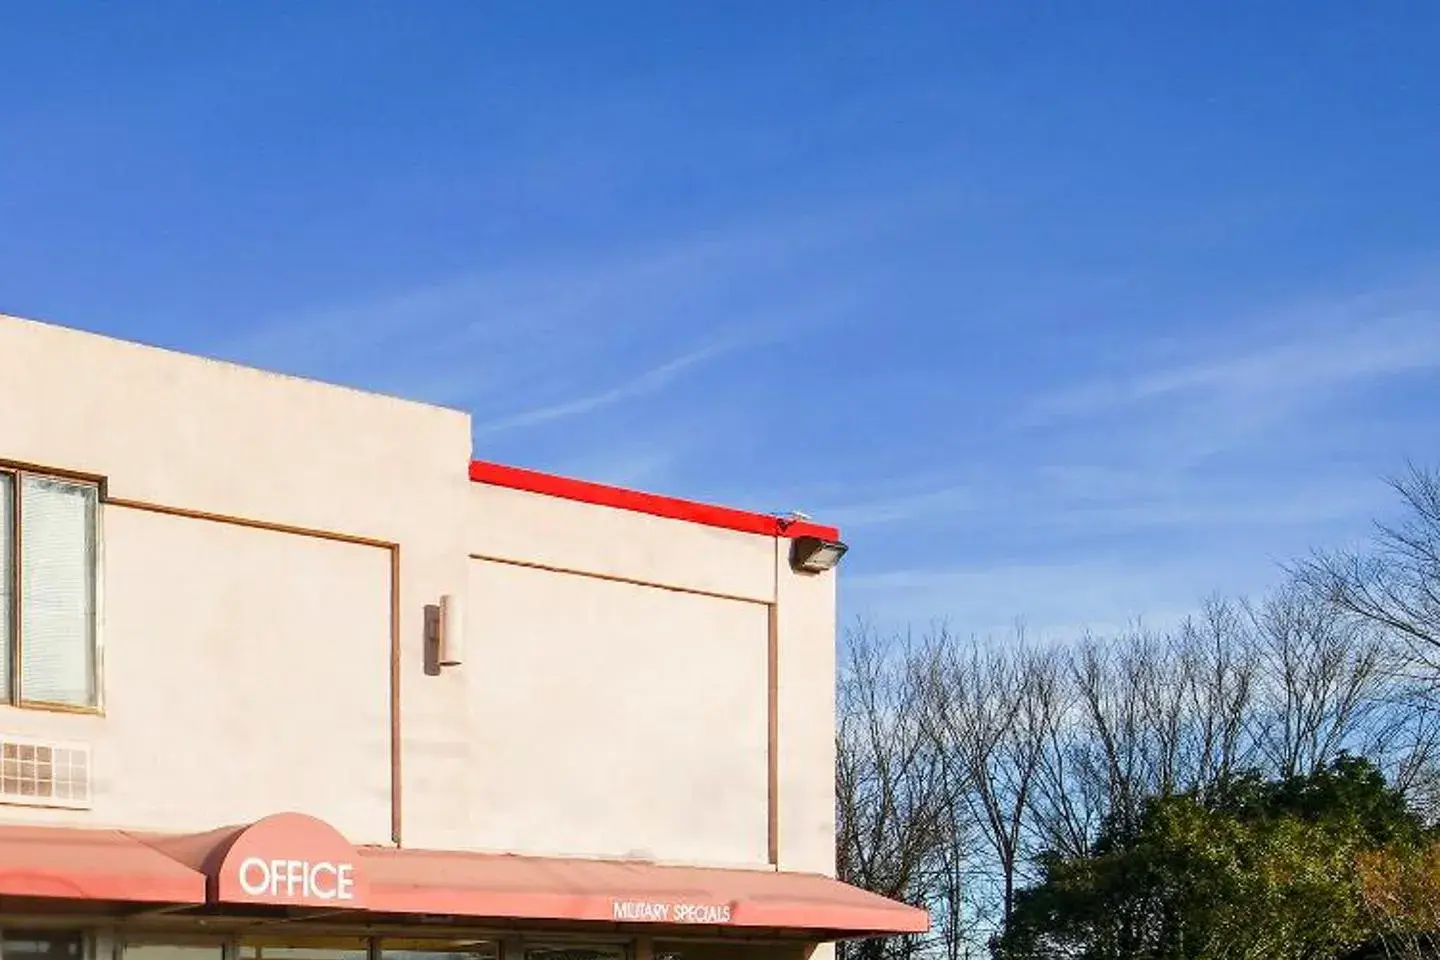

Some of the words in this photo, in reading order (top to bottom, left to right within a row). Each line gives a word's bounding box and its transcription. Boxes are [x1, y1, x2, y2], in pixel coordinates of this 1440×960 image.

[239, 857, 354, 900] OFFICE
[613, 901, 669, 919] MILITARY
[674, 904, 731, 923] SPECIALS
